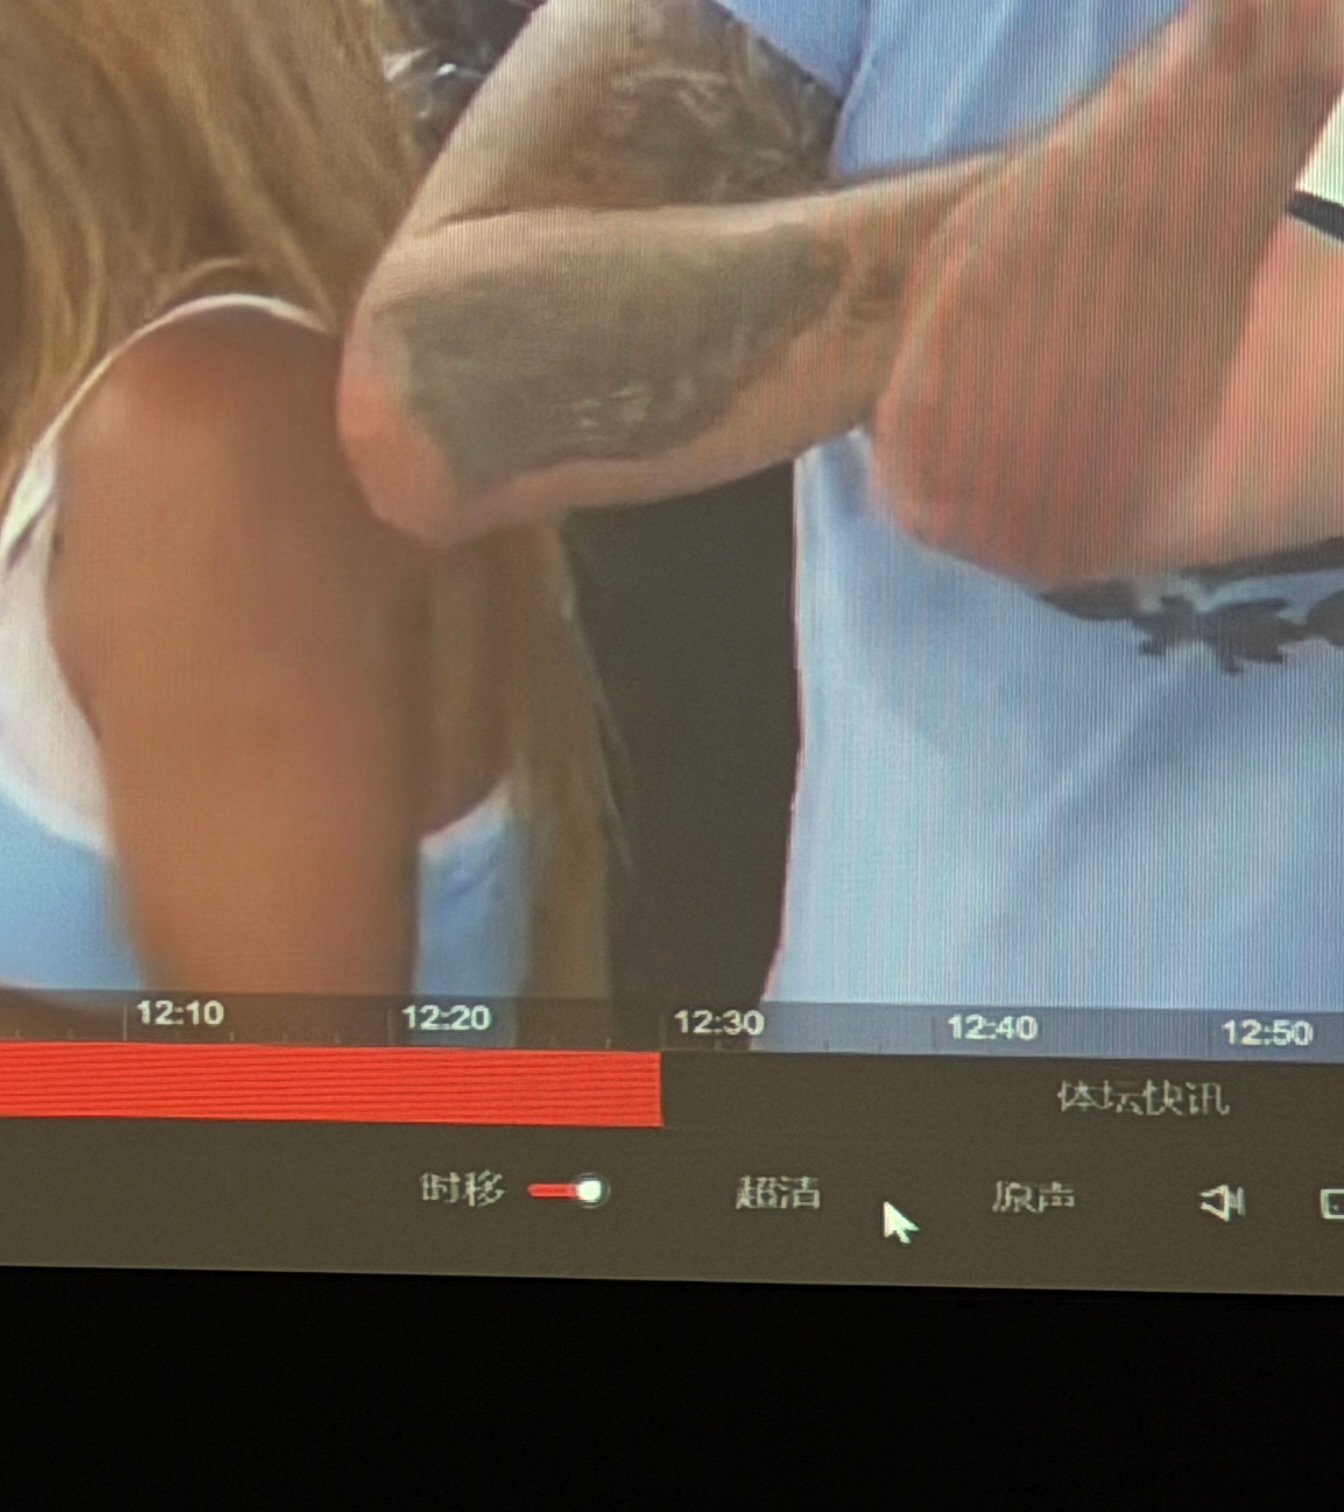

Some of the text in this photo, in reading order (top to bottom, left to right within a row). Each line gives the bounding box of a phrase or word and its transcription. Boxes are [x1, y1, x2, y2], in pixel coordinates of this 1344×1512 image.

[137, 999, 225, 1026] 12:10
[402, 1004, 491, 1031] 12:20
[674, 1008, 765, 1037] 12:30
[948, 1013, 1039, 1041] 12:40
[1222, 1018, 1314, 1048] 12:50
[1056, 1079, 1231, 1116] 体坛快讯
[420, 1170, 505, 1207] 时移
[992, 1179, 1076, 1213] 原声
